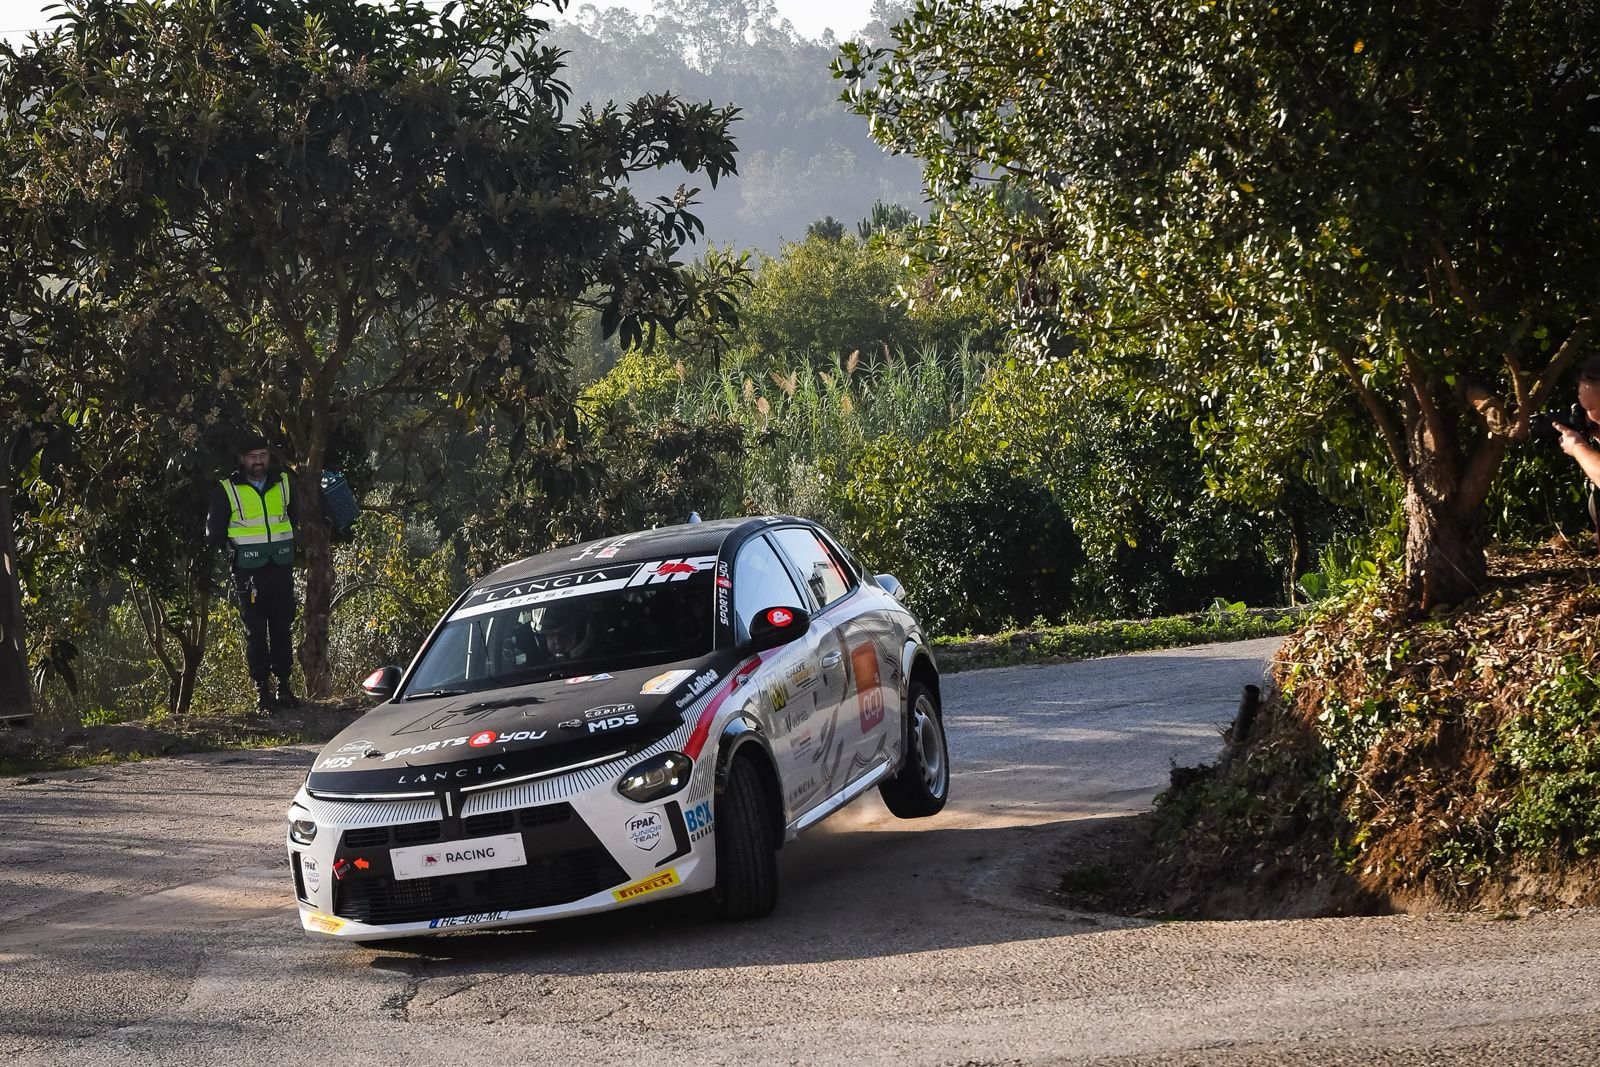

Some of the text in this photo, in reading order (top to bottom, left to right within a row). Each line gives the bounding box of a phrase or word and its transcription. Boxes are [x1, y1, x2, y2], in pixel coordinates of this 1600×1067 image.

[719, 560, 730, 579] YOU
[486, 571, 608, 602] LANCIA
[493, 589, 576, 609] CORSE
[719, 587, 730, 627] SPORTS
[687, 669, 719, 696] LaRoca
[587, 713, 640, 733] MDS
[381, 736, 469, 762] SPORTS
[496, 730, 547, 743] YOU
[319, 756, 357, 769] MDS
[398, 763, 506, 784] LANCIA
[630, 815, 655, 831] FPAK
[684, 801, 713, 833] BOX
[629, 824, 662, 840] JUNIOR
[633, 831, 660, 844] TEAM
[445, 847, 495, 863] RACING
[618, 873, 674, 899] PIRELLI
